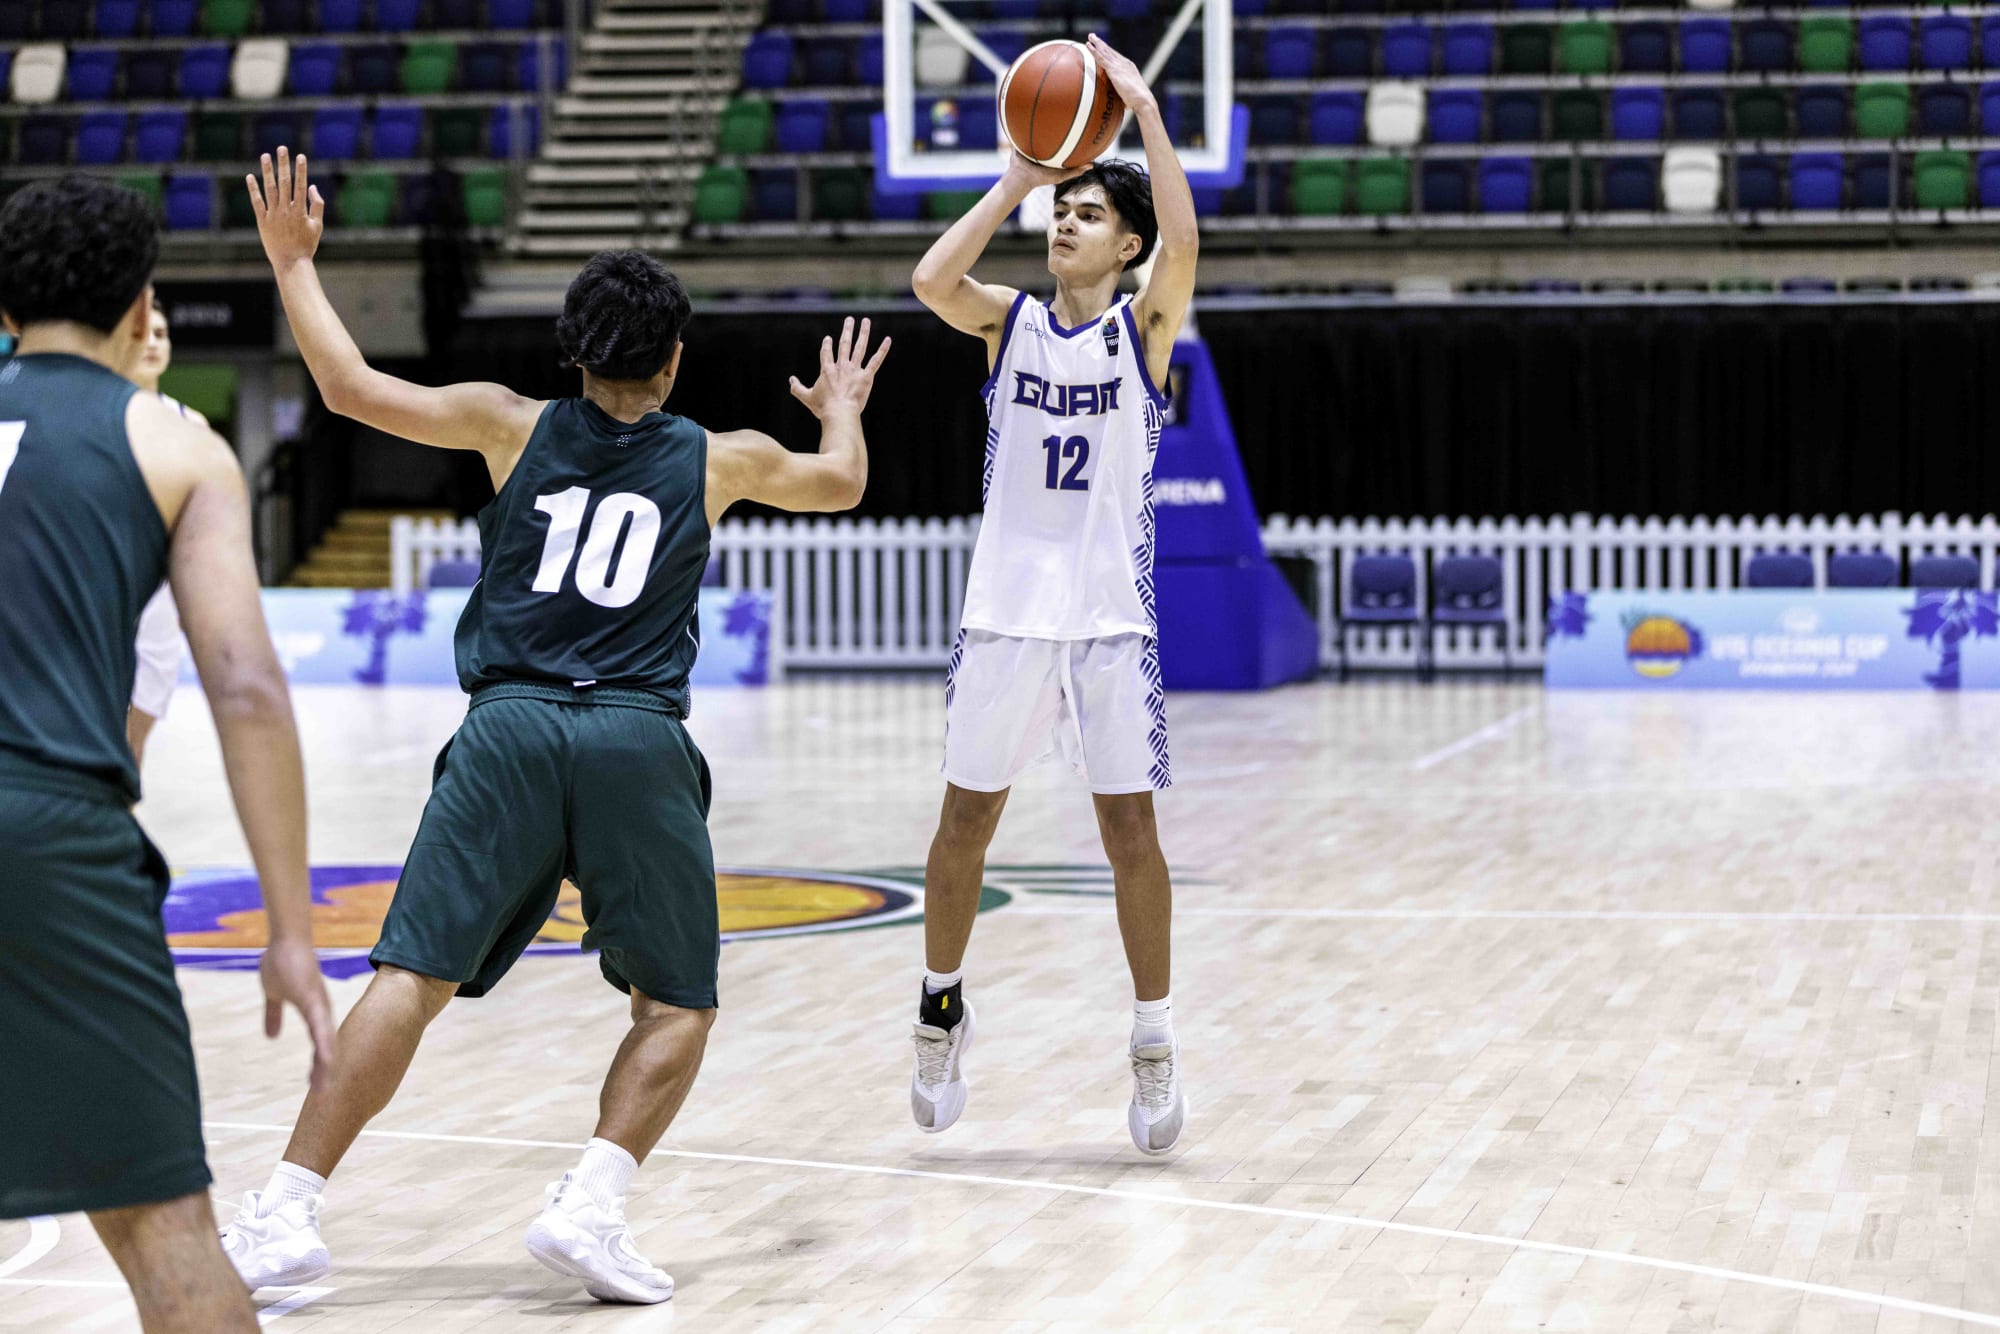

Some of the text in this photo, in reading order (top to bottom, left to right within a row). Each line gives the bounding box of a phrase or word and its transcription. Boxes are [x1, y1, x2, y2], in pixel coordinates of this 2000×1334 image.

[1092, 91, 1114, 144] molten
[1011, 370, 1123, 416] GUAM
[1042, 434, 1090, 491] 12
[1152, 478, 1226, 506] RENA
[531, 485, 662, 608] 10
